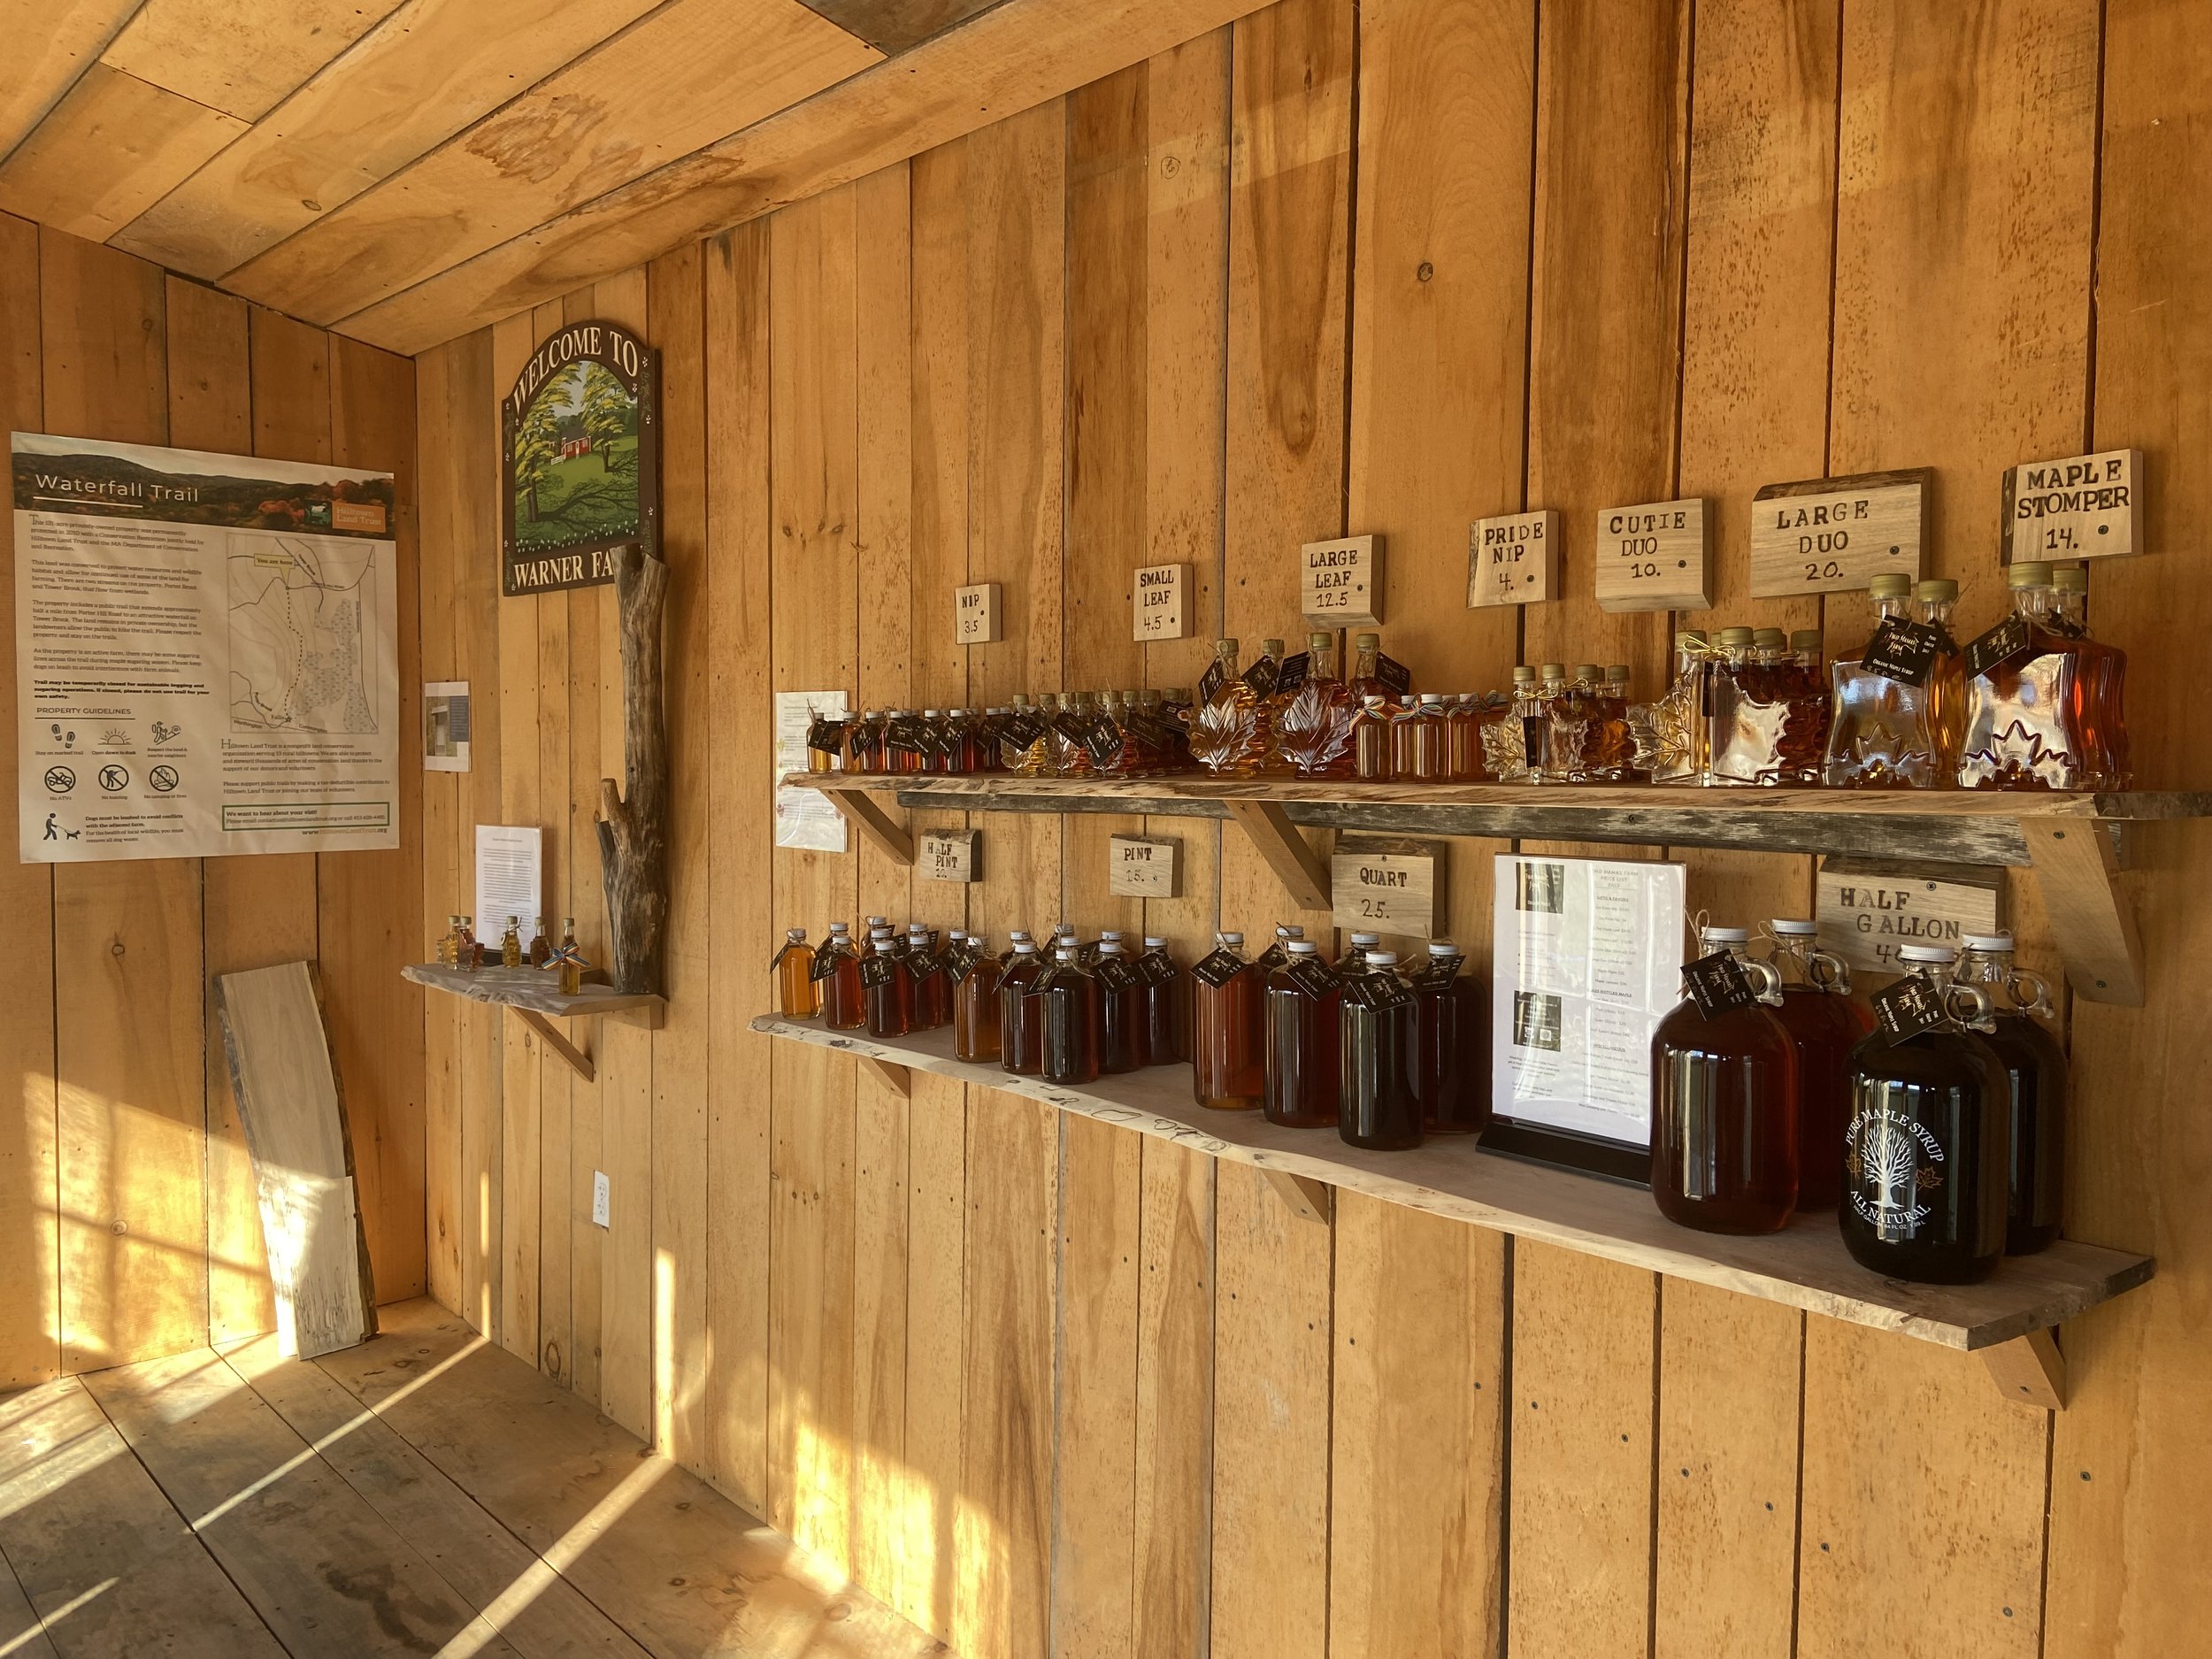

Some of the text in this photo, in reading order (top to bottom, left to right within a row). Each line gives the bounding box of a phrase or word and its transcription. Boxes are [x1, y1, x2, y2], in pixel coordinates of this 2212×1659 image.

[514, 327, 638, 414] WELCOME TO
[2027, 459, 2122, 490] MAPLE
[35, 474, 198, 502] Waterfall Trail
[2017, 486, 2129, 518] STOMPER
[336, 507, 374, 517] Hilltown
[1777, 500, 1869, 529] LARGE
[360, 517, 381, 526] Trust
[1609, 511, 1686, 534] CUTIE
[1485, 522, 1544, 546] PRIDE
[1799, 530, 1849, 555] DUO
[2047, 528, 2078, 549] 14.
[1493, 545, 1525, 564] NIP
[1621, 538, 1657, 556] DUO
[1310, 549, 1357, 567] LARGE
[514, 551, 615, 588] WARNER FA
[1631, 564, 1661, 578] 10.
[1805, 562, 1844, 580] 20.
[1141, 570, 1174, 588] SMALL
[1316, 571, 1351, 588] LEAF
[962, 595, 979, 608] NIP
[1144, 590, 1171, 606] LEAF
[1317, 592, 1348, 608] 12.5
[964, 620, 978, 634] 3.5
[1144, 615, 1162, 631] 4.5
[928, 842, 952, 856] HALF
[1125, 847, 1151, 861] PINT
[936, 855, 957, 868] PINT
[1126, 870, 1144, 882] 15.
[1360, 868, 1407, 887] QUART
[1841, 888, 1910, 910] HALF
[1362, 899, 1390, 918] 25.
[1857, 914, 1960, 939] GALLON
[1846, 1108, 1945, 1162] PURE MAPLE SYRUP
[1851, 1190, 1931, 1224] ALL NATURAL
